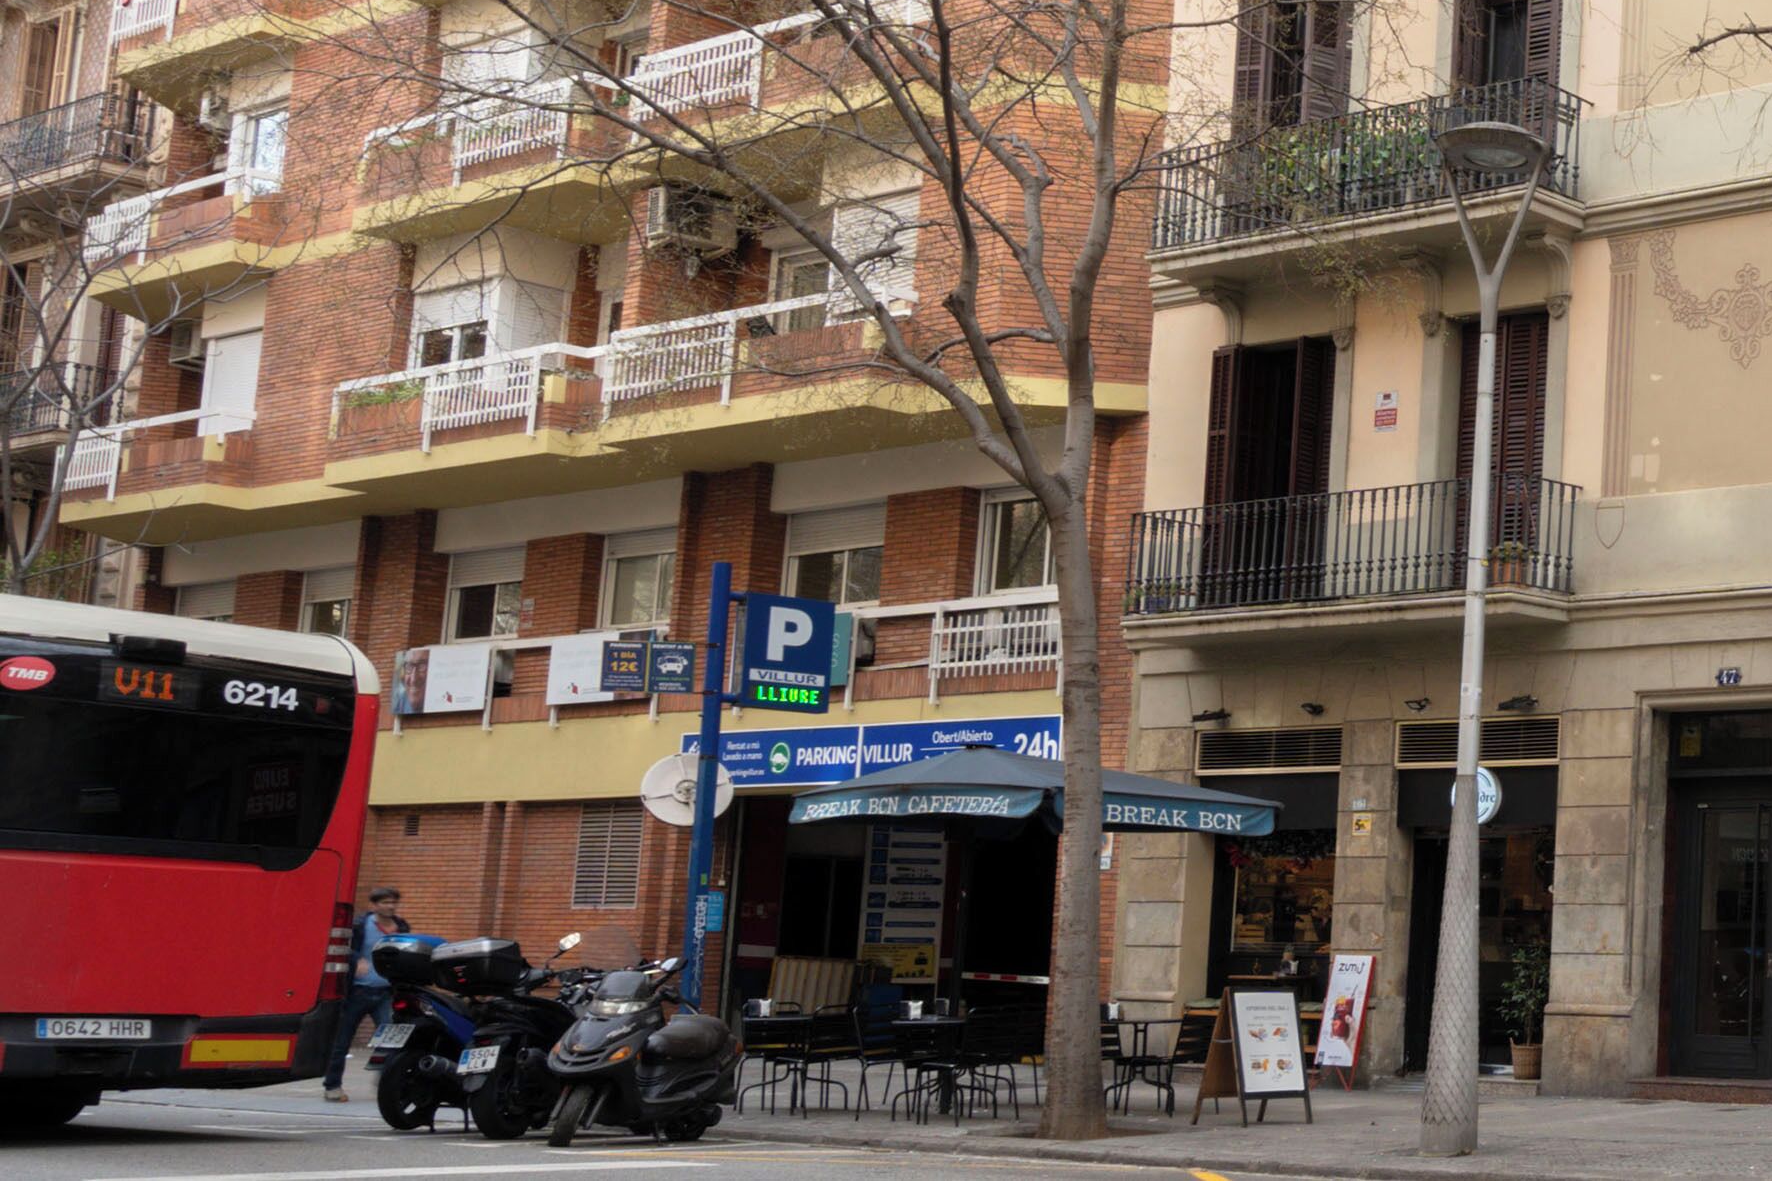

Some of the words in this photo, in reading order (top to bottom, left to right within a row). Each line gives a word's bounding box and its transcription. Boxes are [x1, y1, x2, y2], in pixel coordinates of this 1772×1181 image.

[766, 605, 813, 662] P
[7, 666, 48, 681] TMB
[610, 660, 639, 672] 12€
[114, 666, 174, 701] V11
[757, 670, 818, 685] VILLUR
[1720, 670, 1737, 684] 47
[223, 679, 299, 712] 6214
[757, 685, 820, 705] LLIURE
[932, 730, 994, 744] Obert/Abierto
[1013, 730, 1058, 761] 24h
[796, 745, 857, 766] PARKING
[863, 743, 913, 764] VILLUR
[802, 798, 863, 820] BREAK
[868, 796, 899, 815] BCN
[1106, 804, 1188, 828] BREAK
[1198, 811, 1242, 831] BCN
[51, 1020, 102, 1036] 0642
[109, 1020, 145, 1036] HHR
